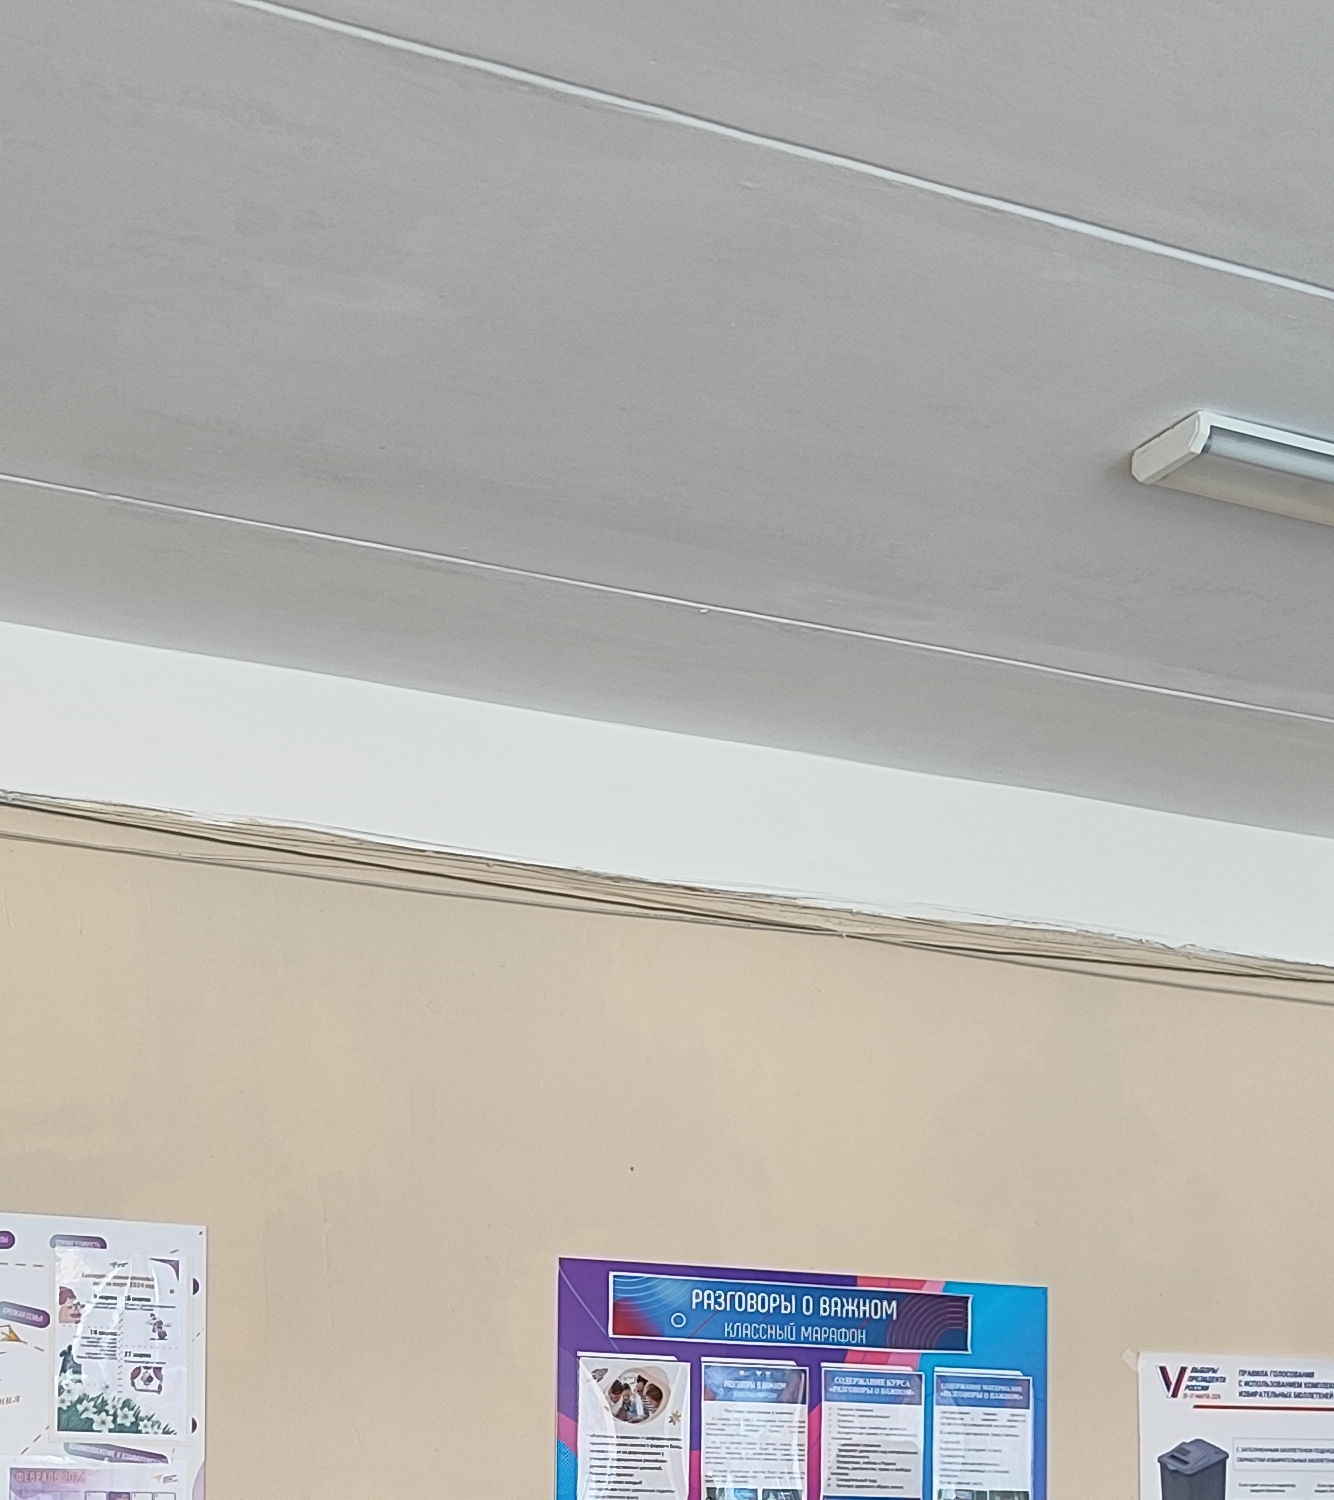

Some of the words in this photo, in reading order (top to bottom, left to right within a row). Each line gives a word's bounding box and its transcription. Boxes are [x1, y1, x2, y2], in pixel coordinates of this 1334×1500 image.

[691, 1288, 796, 1314] РАЗГОВОРЫ
[802, 1295, 813, 1315] О
[820, 1296, 897, 1321] ВАЖНОМ
[724, 1322, 796, 1341] КЛАССНЫЙ
[800, 1326, 866, 1344] МАРАФОН
[15, 1472, 59, 1482] ФЕВРАЛЬ
